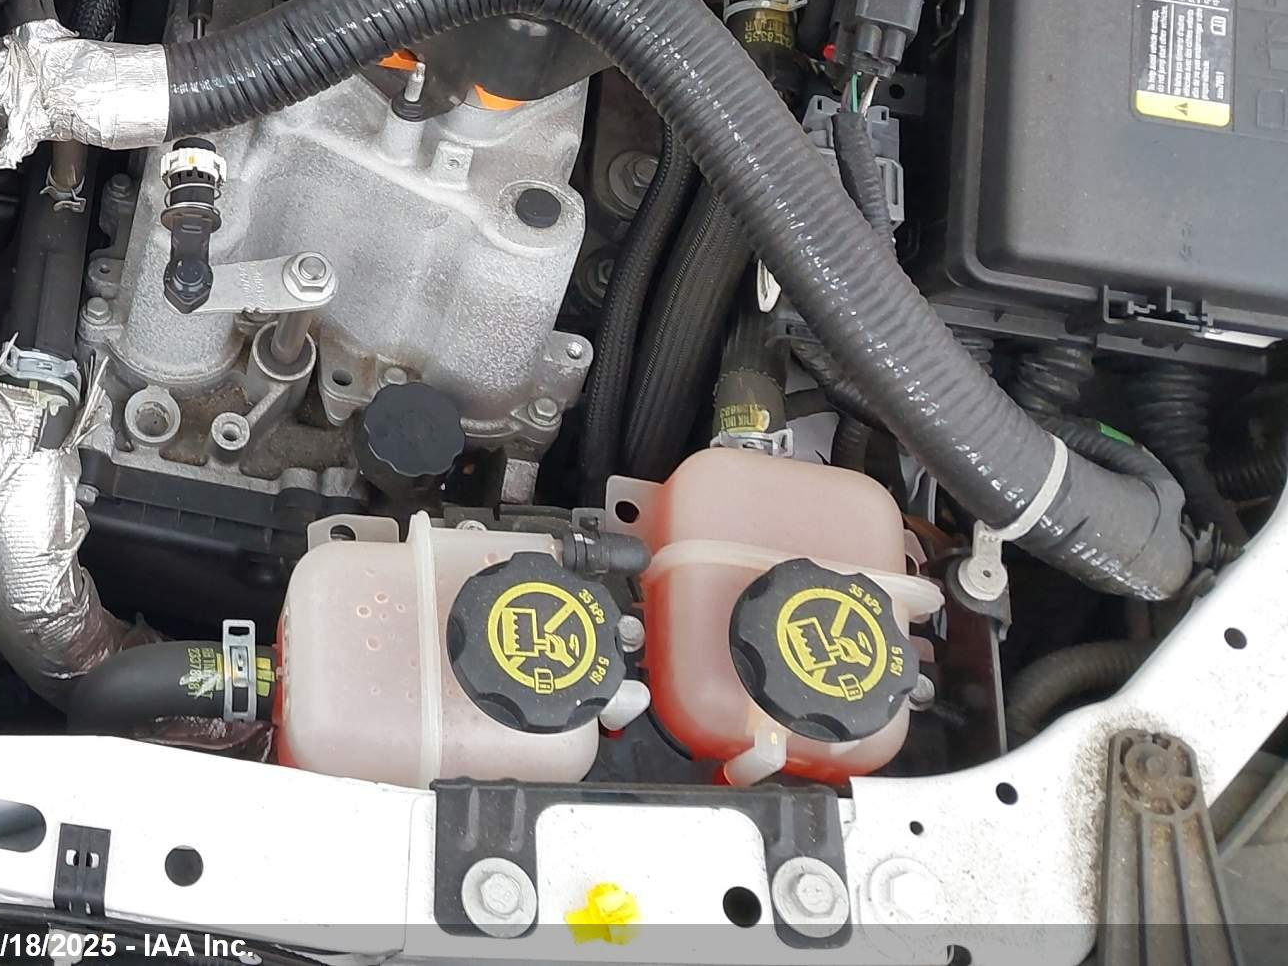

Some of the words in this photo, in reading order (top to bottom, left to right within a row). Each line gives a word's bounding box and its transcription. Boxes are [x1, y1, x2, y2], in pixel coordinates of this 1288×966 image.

[578, 589, 594, 606] 35
[589, 603, 605, 624] kPa
[849, 584, 864, 598] 35
[864, 593, 883, 616] kPa
[598, 657, 609, 665] 5
[892, 647, 903, 656] 5
[590, 666, 608, 686] PSI
[890, 657, 903, 676] PSI
